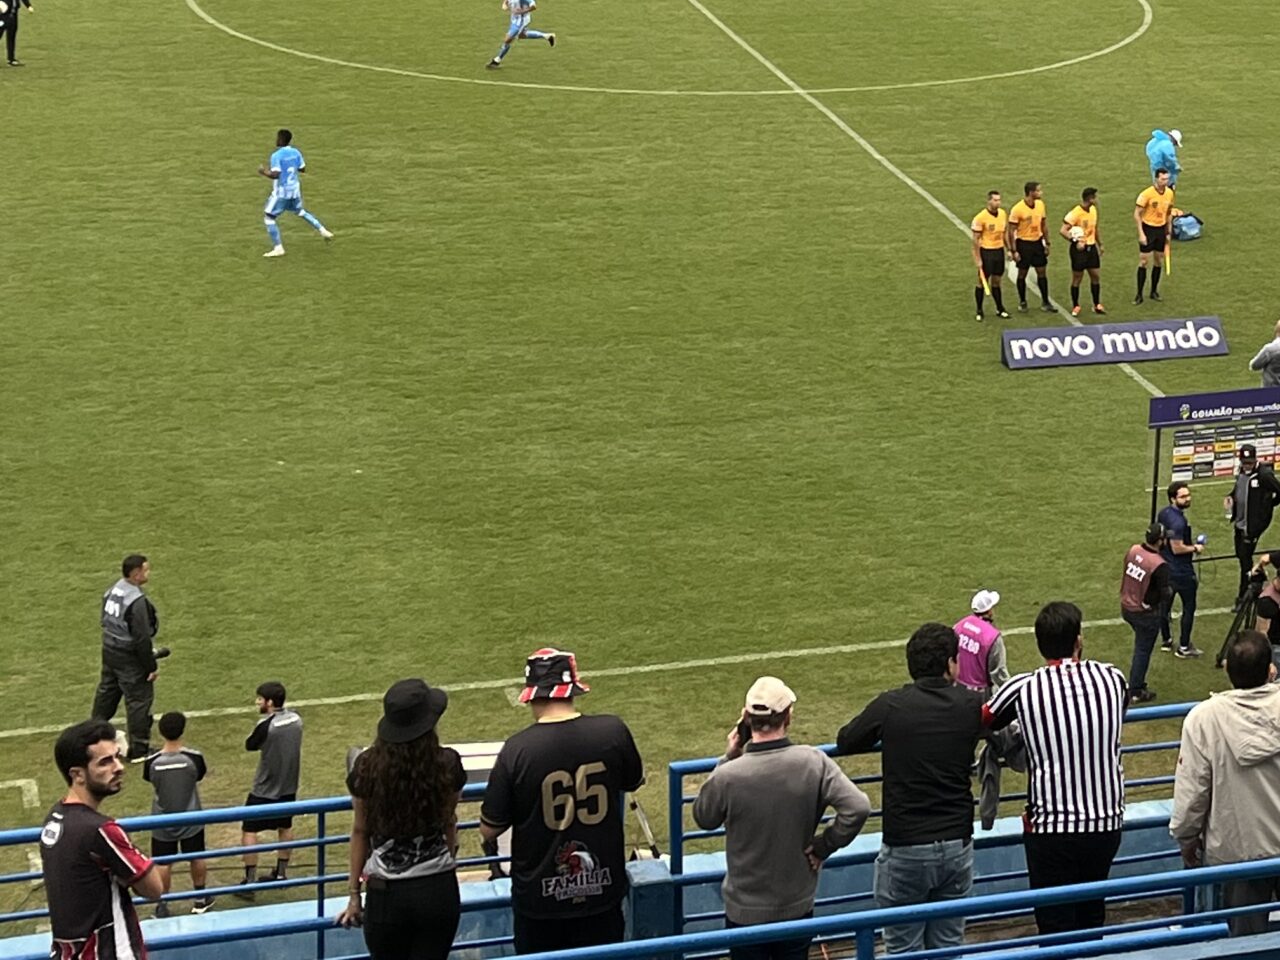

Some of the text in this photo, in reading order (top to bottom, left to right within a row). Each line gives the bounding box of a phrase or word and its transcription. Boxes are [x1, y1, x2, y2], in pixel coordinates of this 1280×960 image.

[1009, 320, 1220, 360] novo mundo
[1192, 402, 1280, 419] GOIANÃO novo mundo
[542, 760, 608, 830] 65
[542, 867, 612, 897] FAMÍLIA
